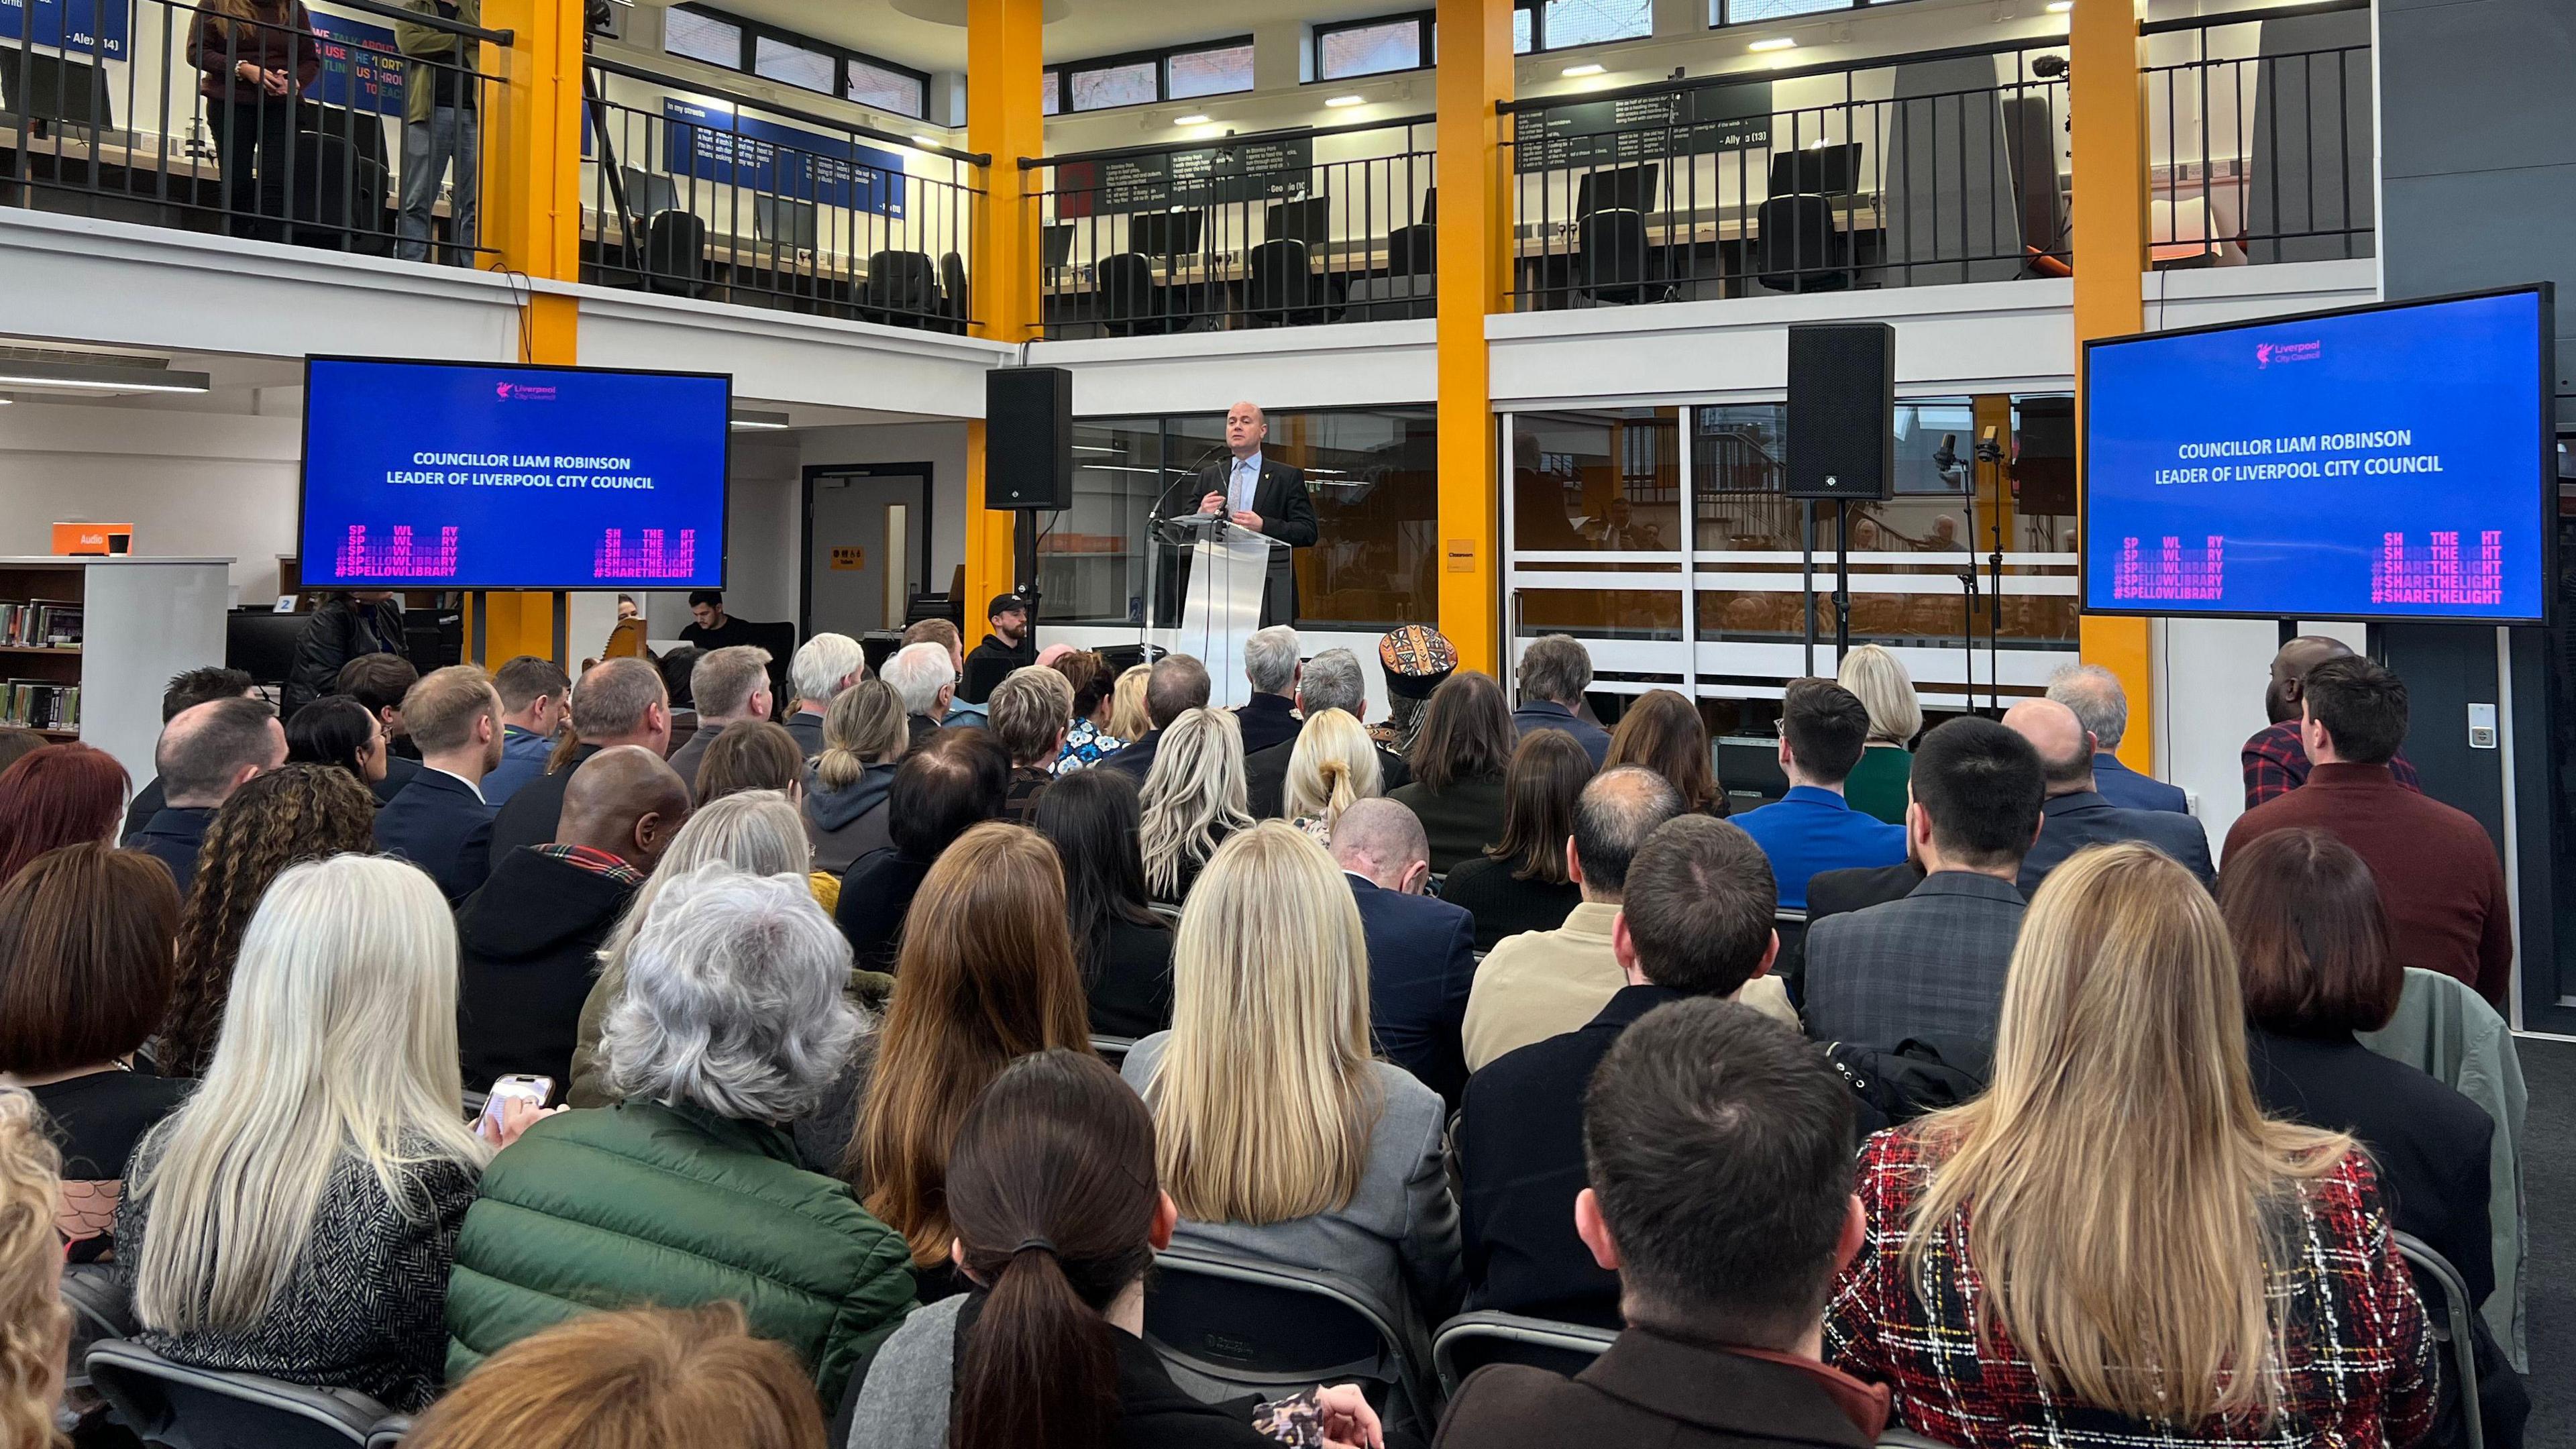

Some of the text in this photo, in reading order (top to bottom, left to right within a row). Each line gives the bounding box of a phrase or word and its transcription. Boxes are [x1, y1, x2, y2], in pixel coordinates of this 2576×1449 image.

[1752, 131, 1766, 142] (13)
[2178, 429, 2412, 460] COUNCILLOR LIAM ROBINSON
[413, 451, 631, 470] COUNCILLOR LIAM ROBINSON
[2155, 455, 2443, 485] LEADER OF LIVERPOOL CITY COUNCIL
[386, 471, 655, 490] LEADER OF LIVERPOOL CITY COUNCIL
[80, 534, 103, 545] Audio
[335, 566, 457, 578] #SPELLOWLIBRARY
[594, 568, 694, 578] #SHARETHELIGHT
[2114, 586, 2223, 600] #SPELLOWLIBRARY
[2371, 588, 2502, 604] #SHARETHELIGHT
[280, 599, 290, 610] 2
